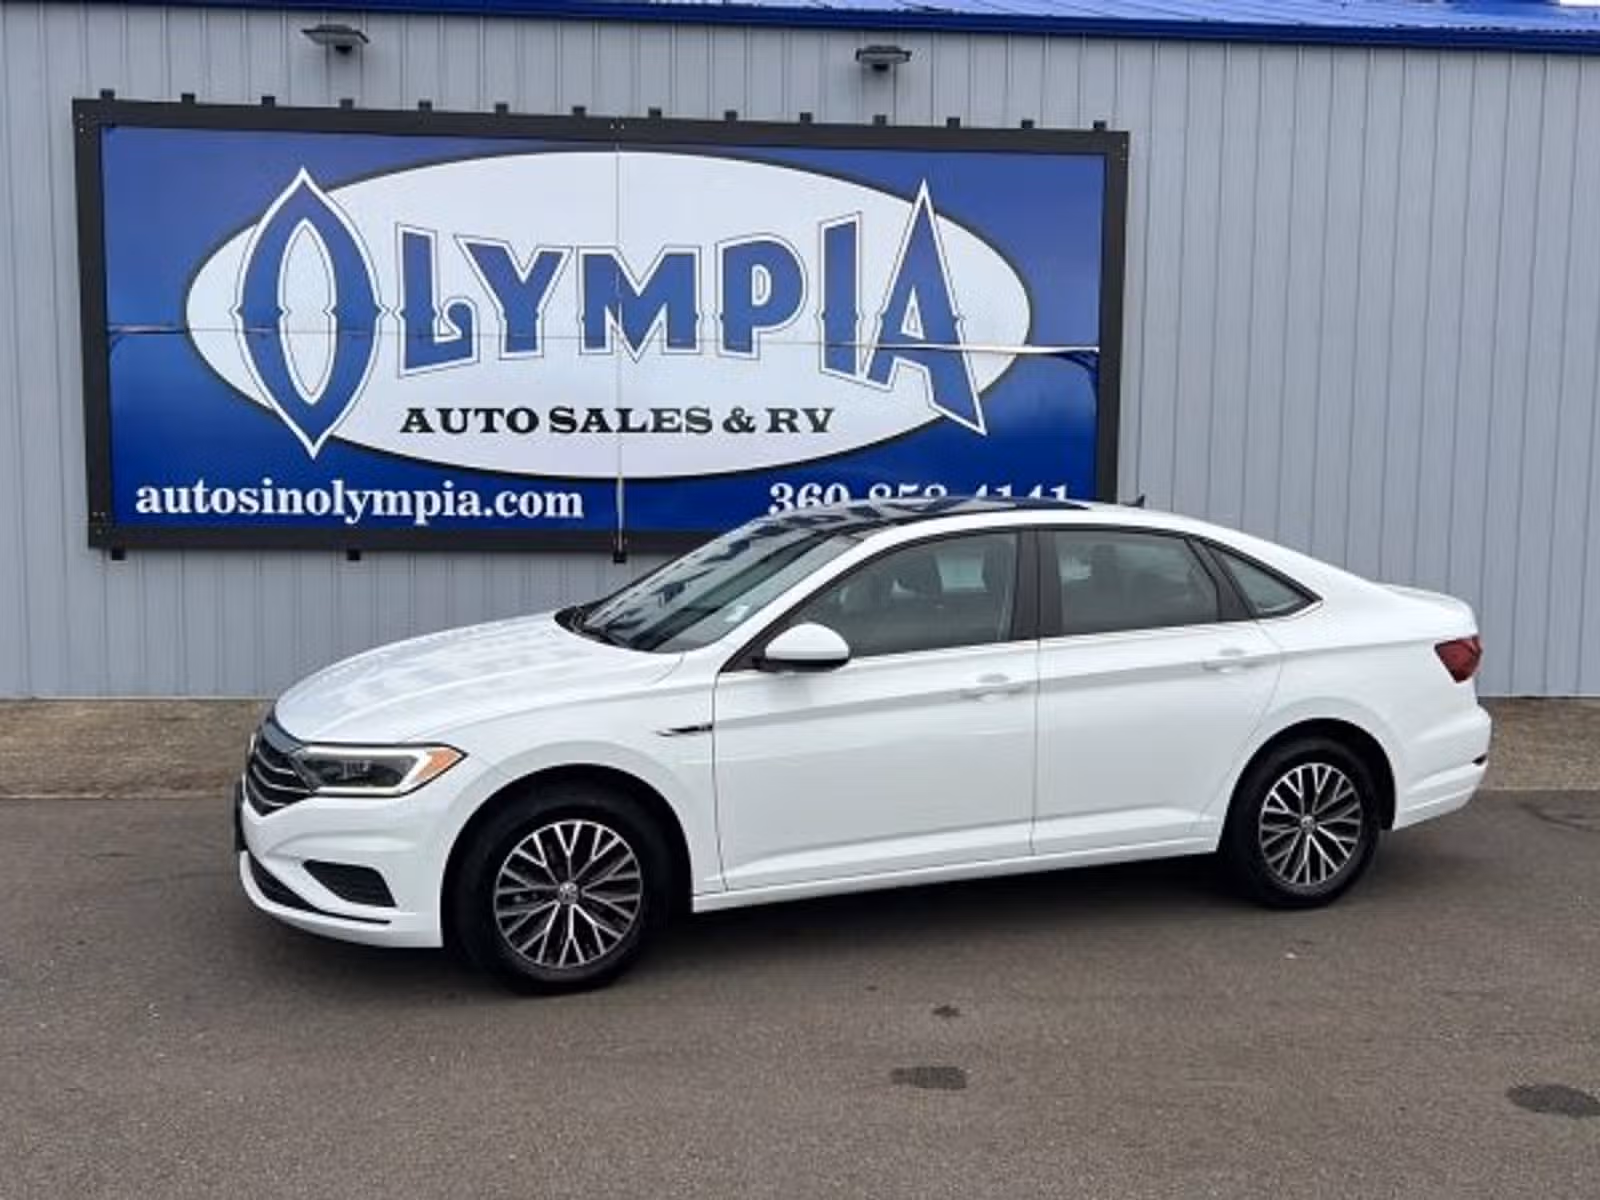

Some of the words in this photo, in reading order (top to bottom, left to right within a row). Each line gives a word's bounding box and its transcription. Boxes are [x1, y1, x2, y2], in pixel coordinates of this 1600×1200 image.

[231, 167, 987, 460] OLYMPIA
[400, 407, 538, 433] AUTO
[549, 407, 712, 433] SALES
[722, 408, 756, 433] &
[768, 408, 834, 433] RV
[135, 477, 584, 526] autosinolympia.com
